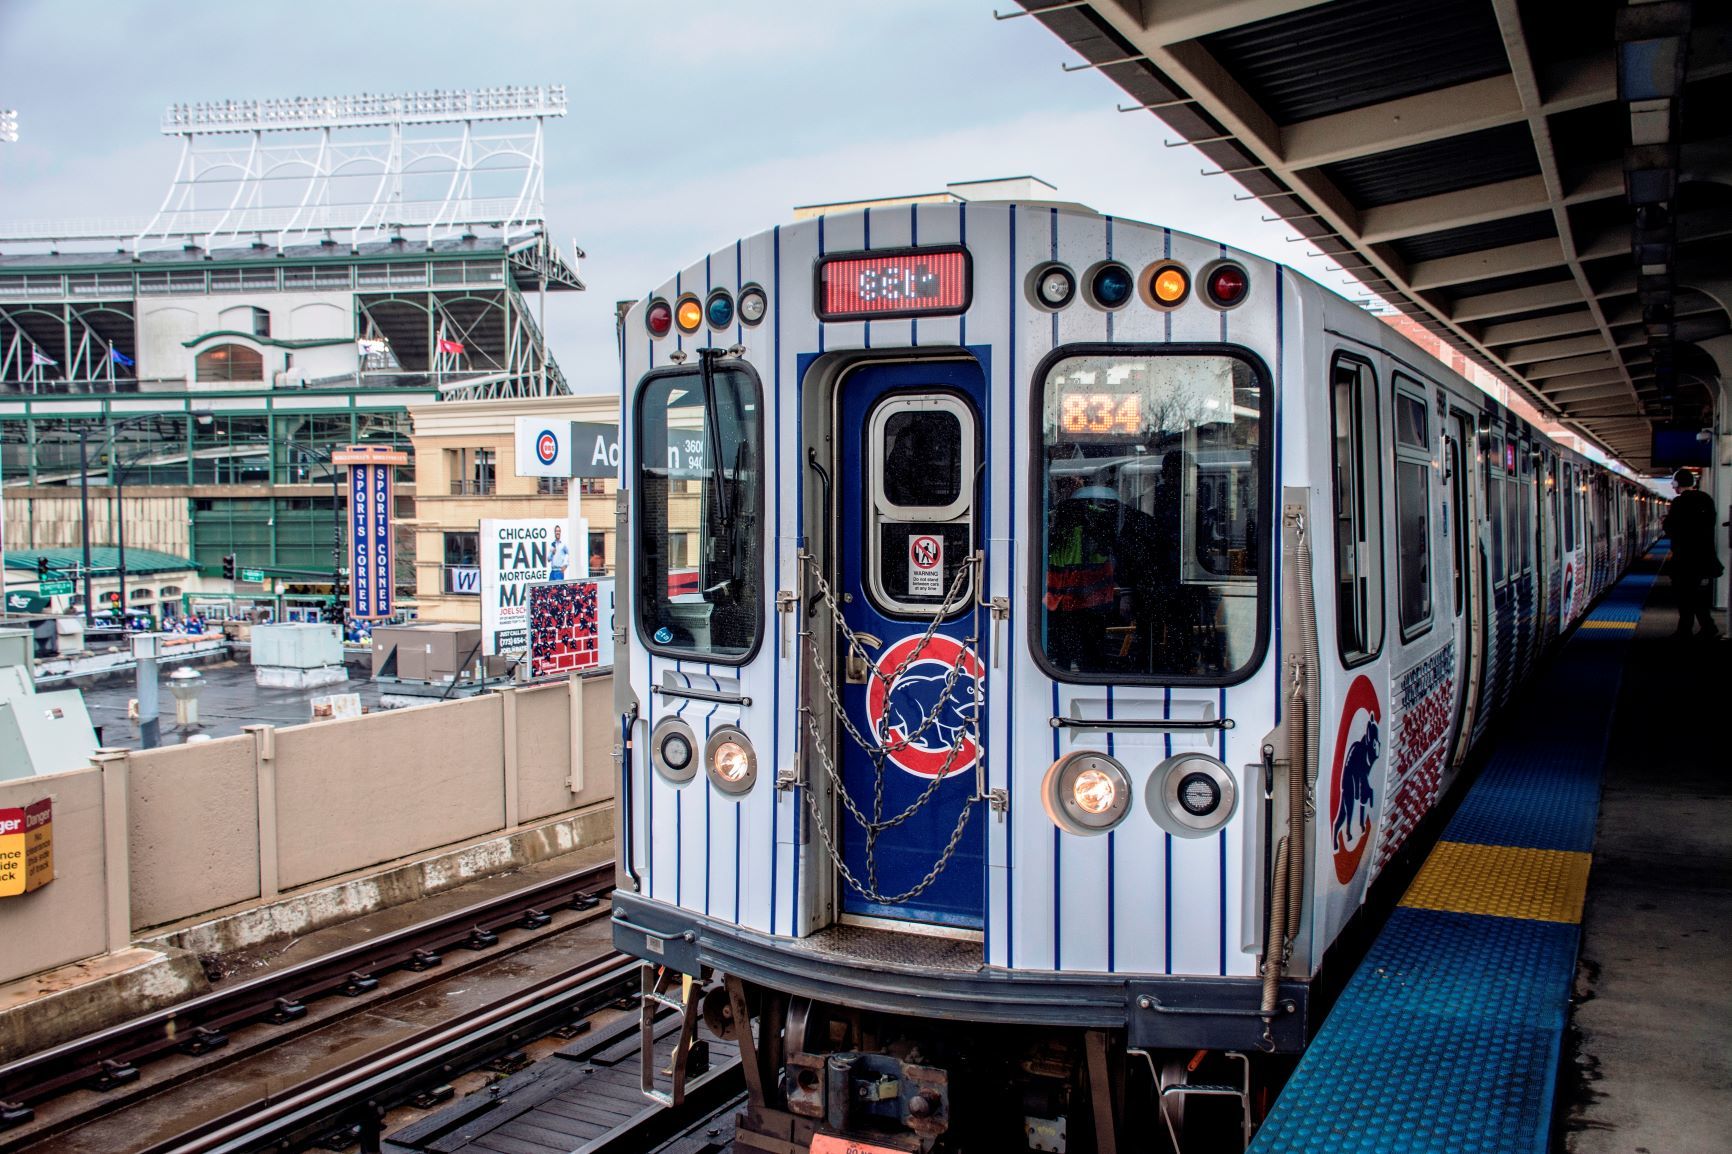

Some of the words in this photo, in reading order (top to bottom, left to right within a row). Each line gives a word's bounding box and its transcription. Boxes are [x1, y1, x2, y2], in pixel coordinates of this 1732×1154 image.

[1063, 394, 1140, 431] 834
[356, 469, 366, 537] SPORTS
[376, 469, 386, 537] SPORTS
[498, 528, 547, 540] CHICAGO
[498, 541, 547, 570] FAN
[357, 543, 367, 611] CORNER
[377, 543, 387, 611] CORNER
[458, 571, 477, 590] W
[499, 570, 547, 582] MORTGAGE
[499, 608, 515, 616] JOEL
